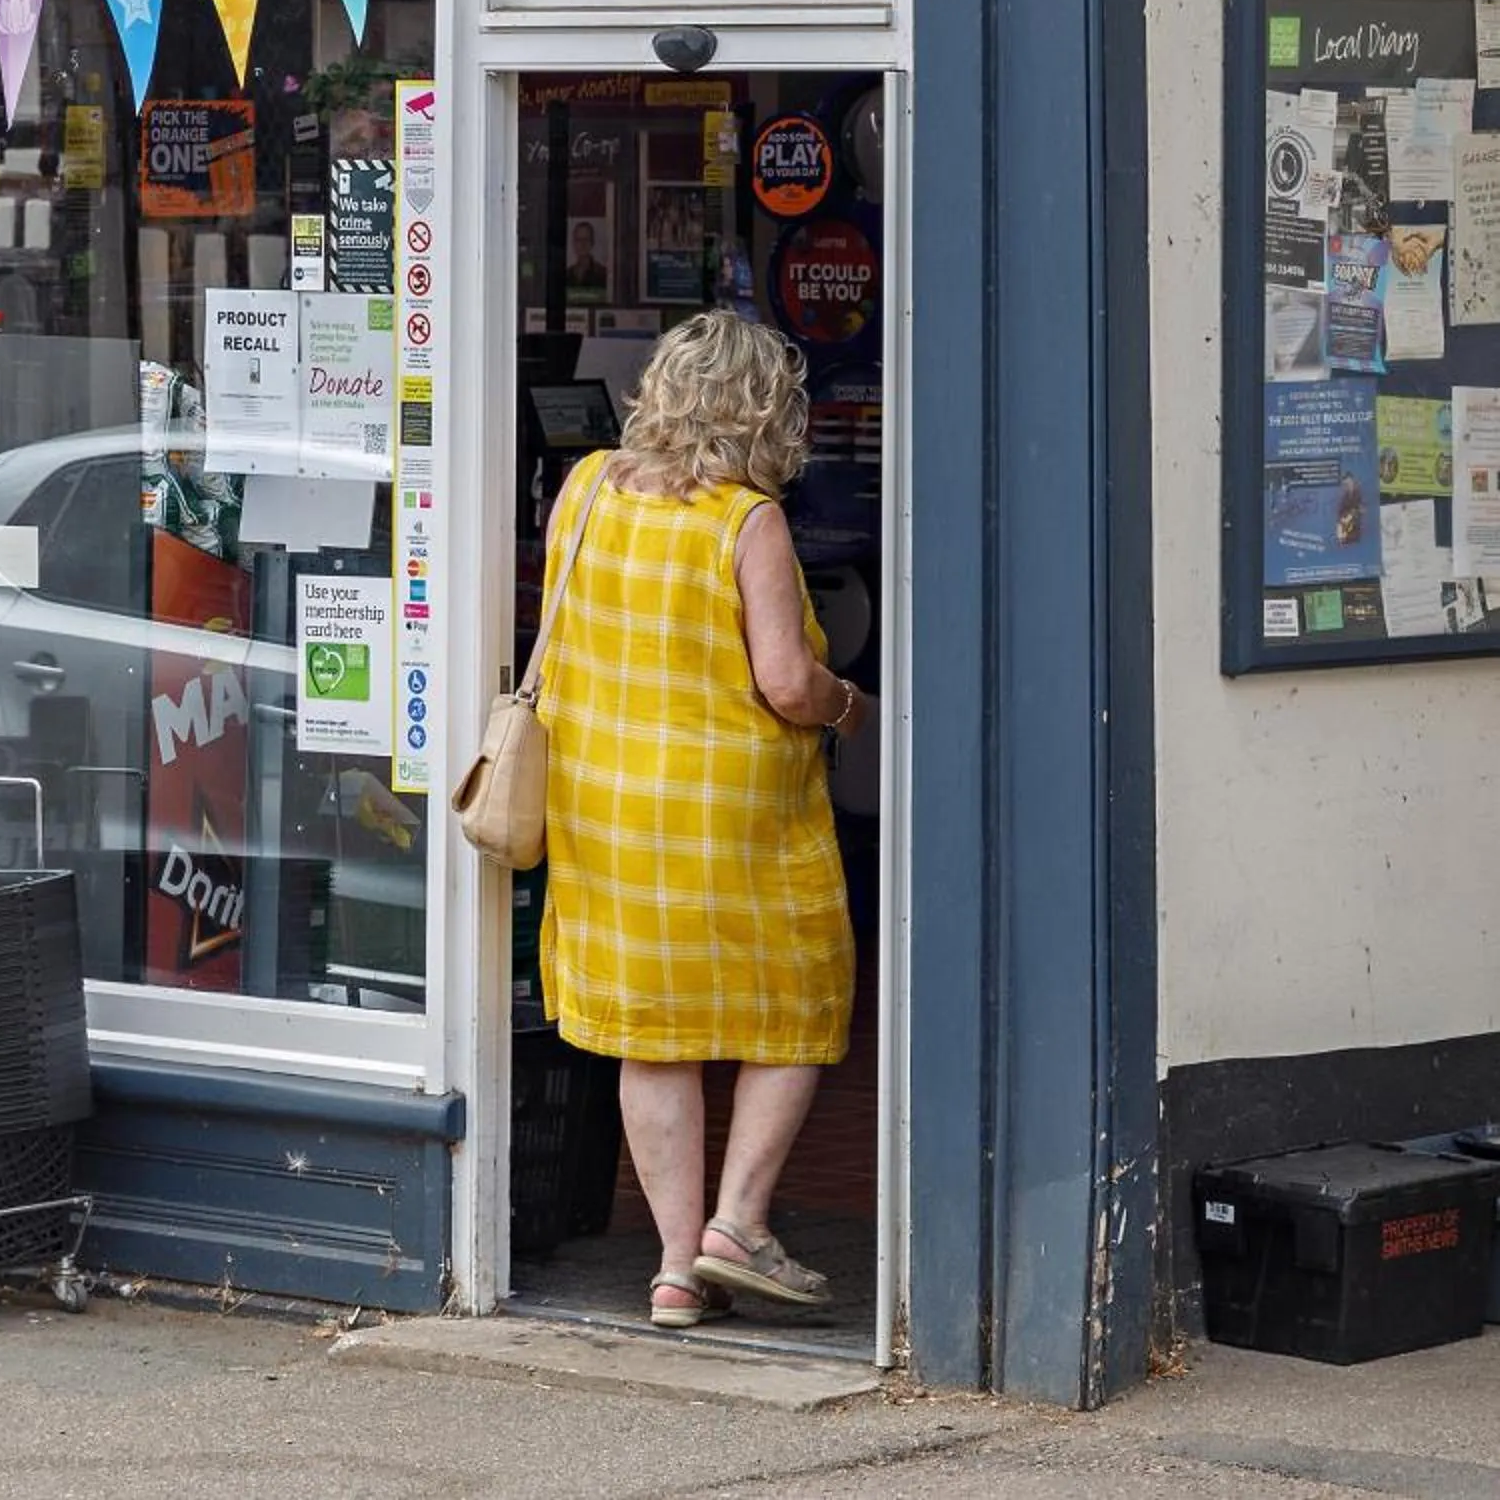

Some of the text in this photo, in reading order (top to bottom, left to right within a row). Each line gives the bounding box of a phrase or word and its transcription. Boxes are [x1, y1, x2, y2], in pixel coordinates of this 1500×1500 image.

[1313, 21, 1420, 72] Local Diary
[151, 110, 209, 125] PICK THE
[151, 127, 209, 143] ORANGE
[151, 143, 209, 174] ONE
[761, 143, 823, 168] PLAY
[339, 197, 388, 213] We take
[339, 214, 373, 230] crime
[339, 231, 391, 250] seriously
[789, 263, 871, 282] IT COULD
[798, 283, 862, 301] BE YOU
[217, 311, 287, 327] PRODUCT
[223, 336, 281, 352] RECALL
[309, 366, 384, 398] Donate
[305, 583, 360, 603] Use your
[305, 604, 385, 624] membership
[305, 622, 363, 639] card here
